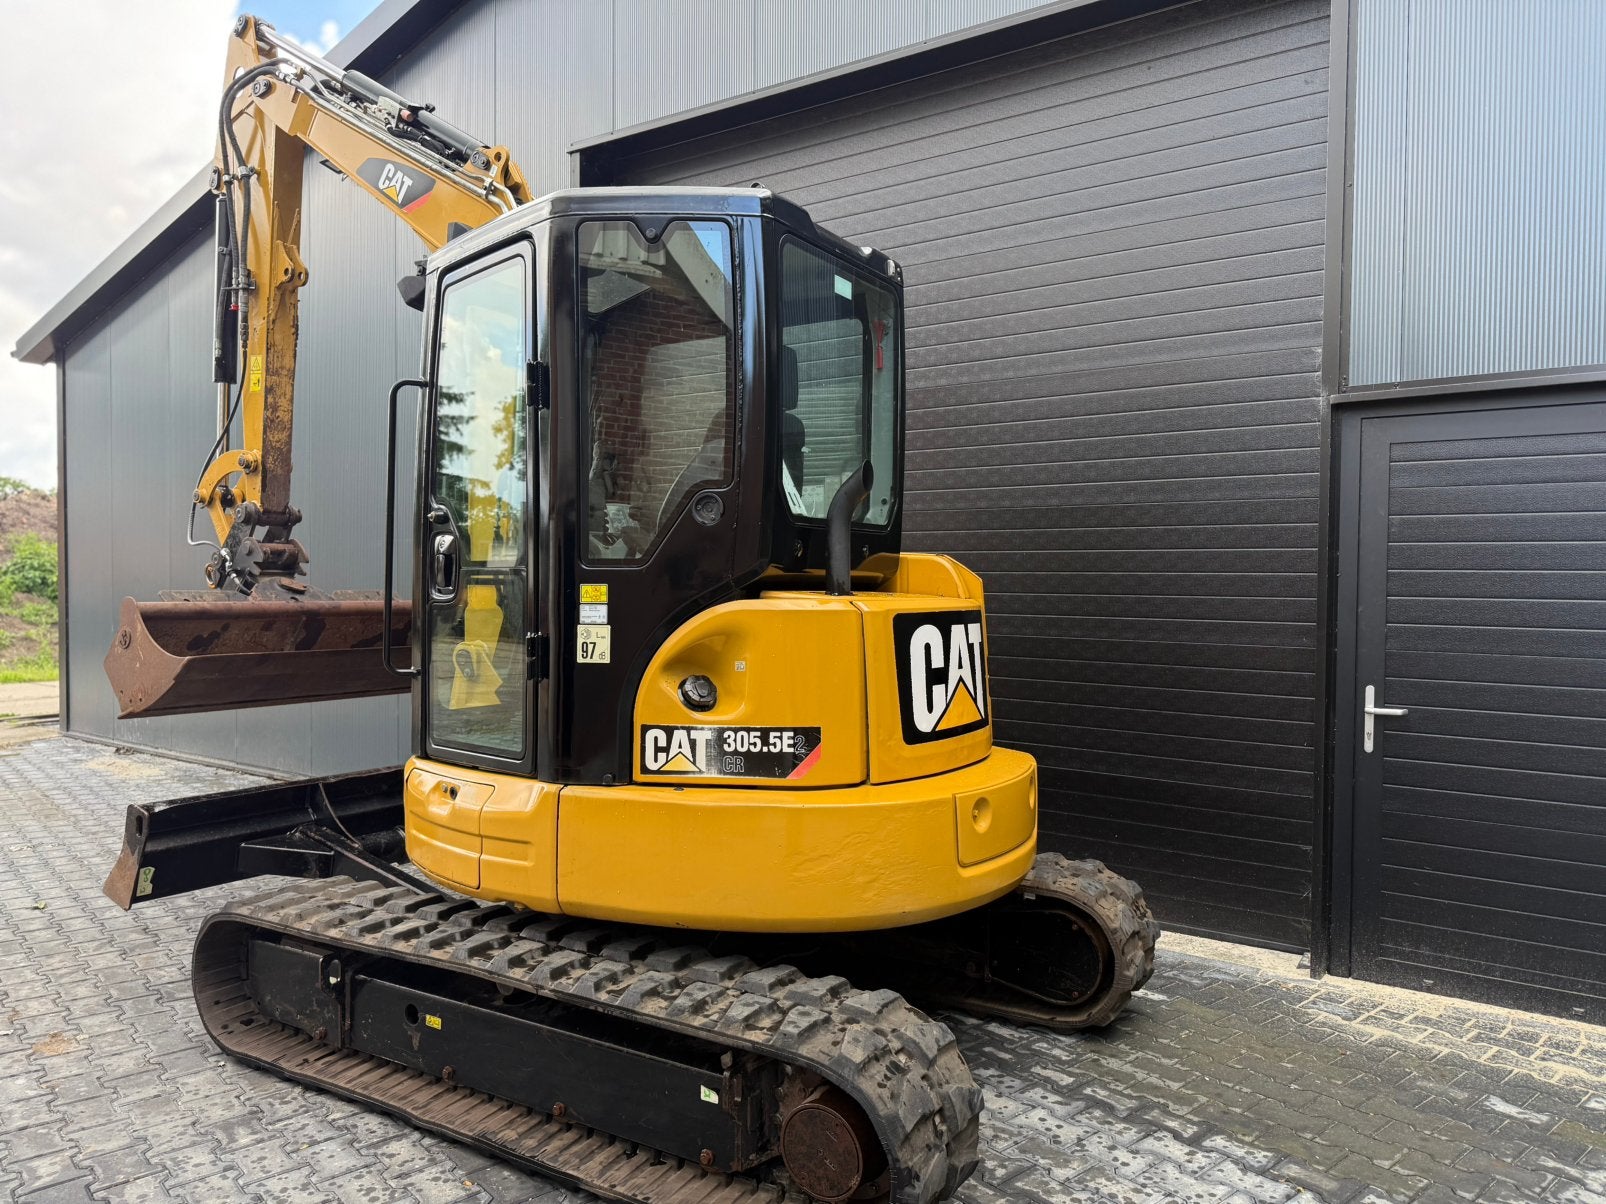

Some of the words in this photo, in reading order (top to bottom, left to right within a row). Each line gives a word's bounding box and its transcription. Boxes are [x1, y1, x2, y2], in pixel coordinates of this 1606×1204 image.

[378, 163, 413, 204] CAT
[581, 641, 597, 660] 97
[909, 622, 985, 733] CAT
[645, 728, 712, 771] CAT
[723, 755, 745, 772] CR
